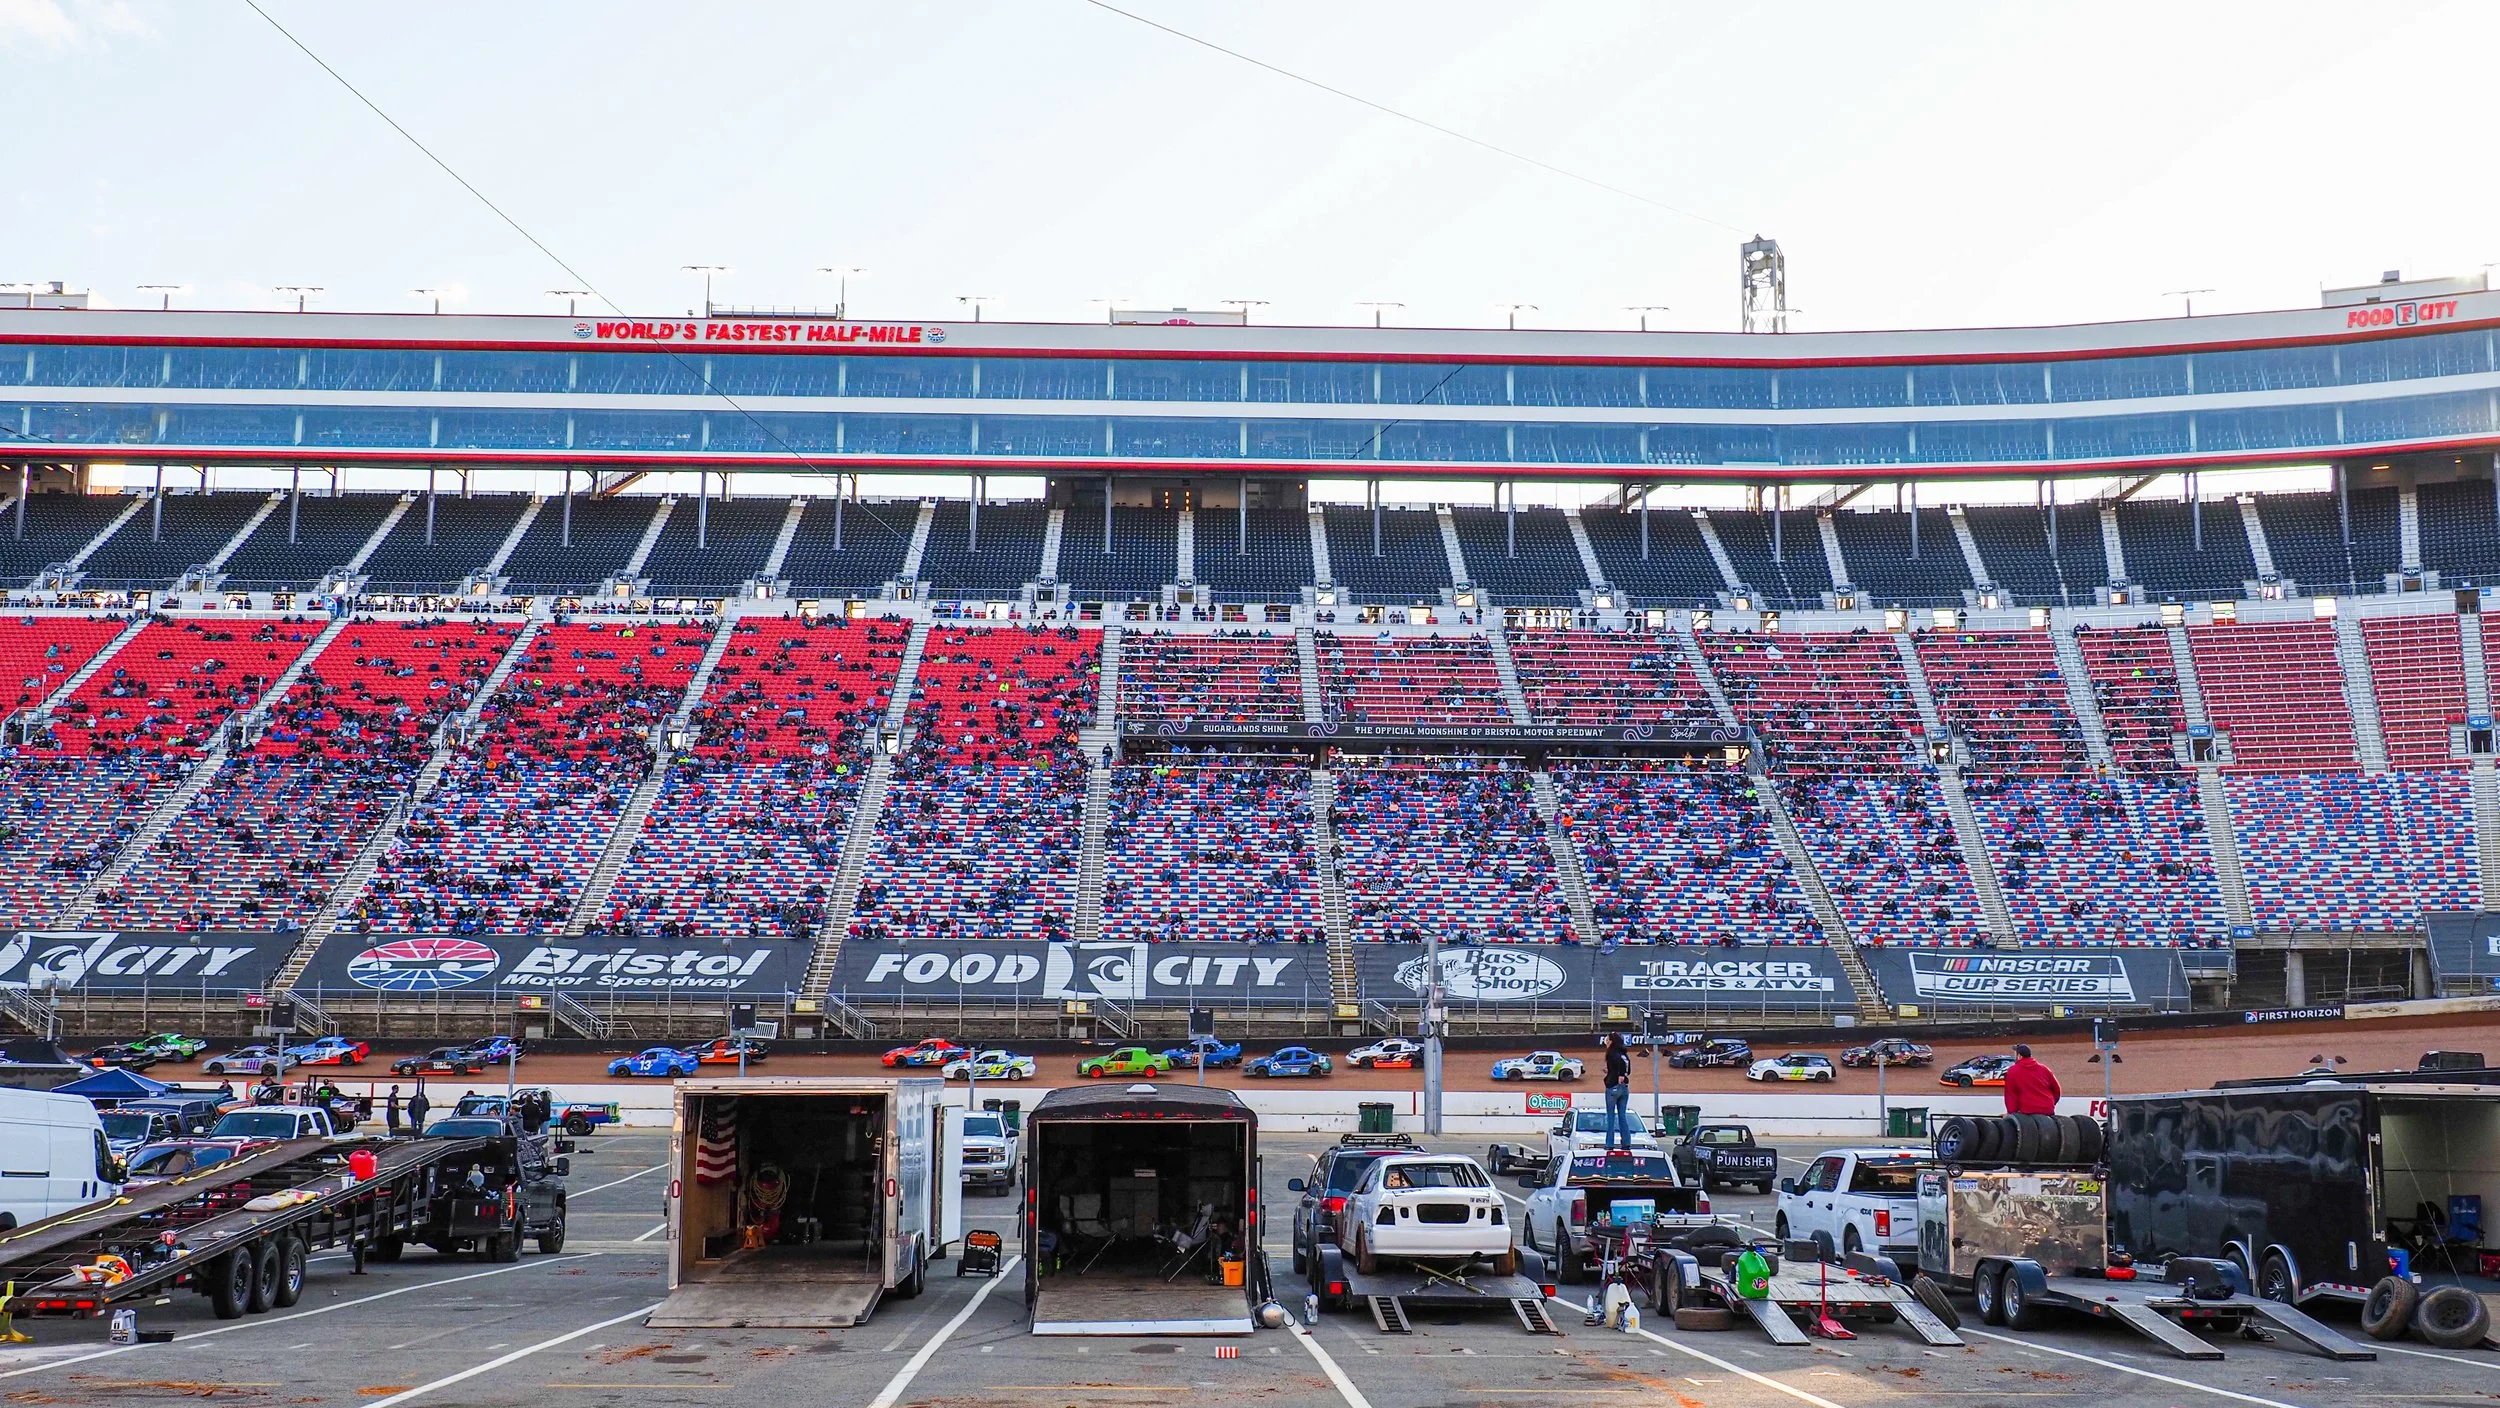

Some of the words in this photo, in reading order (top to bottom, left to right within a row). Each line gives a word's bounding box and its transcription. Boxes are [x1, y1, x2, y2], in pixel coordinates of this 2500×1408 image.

[2347, 308, 2395, 328] FOOD
[2418, 300, 2458, 320] CITY
[596, 323, 697, 340] WORLD'S
[705, 324, 802, 341] FASTEST
[807, 325, 922, 343] HALF-MILE
[1203, 725, 1260, 733] SUGARLANDS
[1262, 725, 1289, 733] SHINE
[1354, 726, 1373, 734] THE
[1375, 726, 1415, 735] OFFICIAL
[1418, 727, 1468, 735] MOONSHINE
[1471, 728, 1483, 736] OF
[1485, 728, 1521, 736] BRISTOL
[1524, 728, 1554, 736] MOTOR
[1556, 728, 1604, 736] SPEEDWAY
[97, 945, 257, 976] CITY
[512, 948, 771, 976] Bristol
[1465, 950, 1530, 964] Bass
[865, 952, 1041, 984] FOOD
[1152, 956, 1294, 986] CITY
[1470, 964, 1516, 976] Pro
[1640, 961, 1813, 977] TRACKER
[1979, 959, 2091, 973] NASCAR
[501, 974, 591, 987] Motor
[596, 975, 747, 989] Speedway
[1472, 975, 1553, 992] Shops
[1634, 978, 1727, 988] BOATS
[1735, 979, 1747, 989] &
[1944, 977, 1998, 991] CUP
[2004, 979, 2099, 992] SERIES
[2258, 1011, 2289, 1021] FIRST
[2291, 1008, 2341, 1019] HORIZON
[1685, 1034, 1703, 1043] CITY
[1529, 1094, 1568, 1110] O'Reilly
[1717, 1156, 1773, 1167] PUNISHER
[2076, 1180, 2099, 1193] 34
